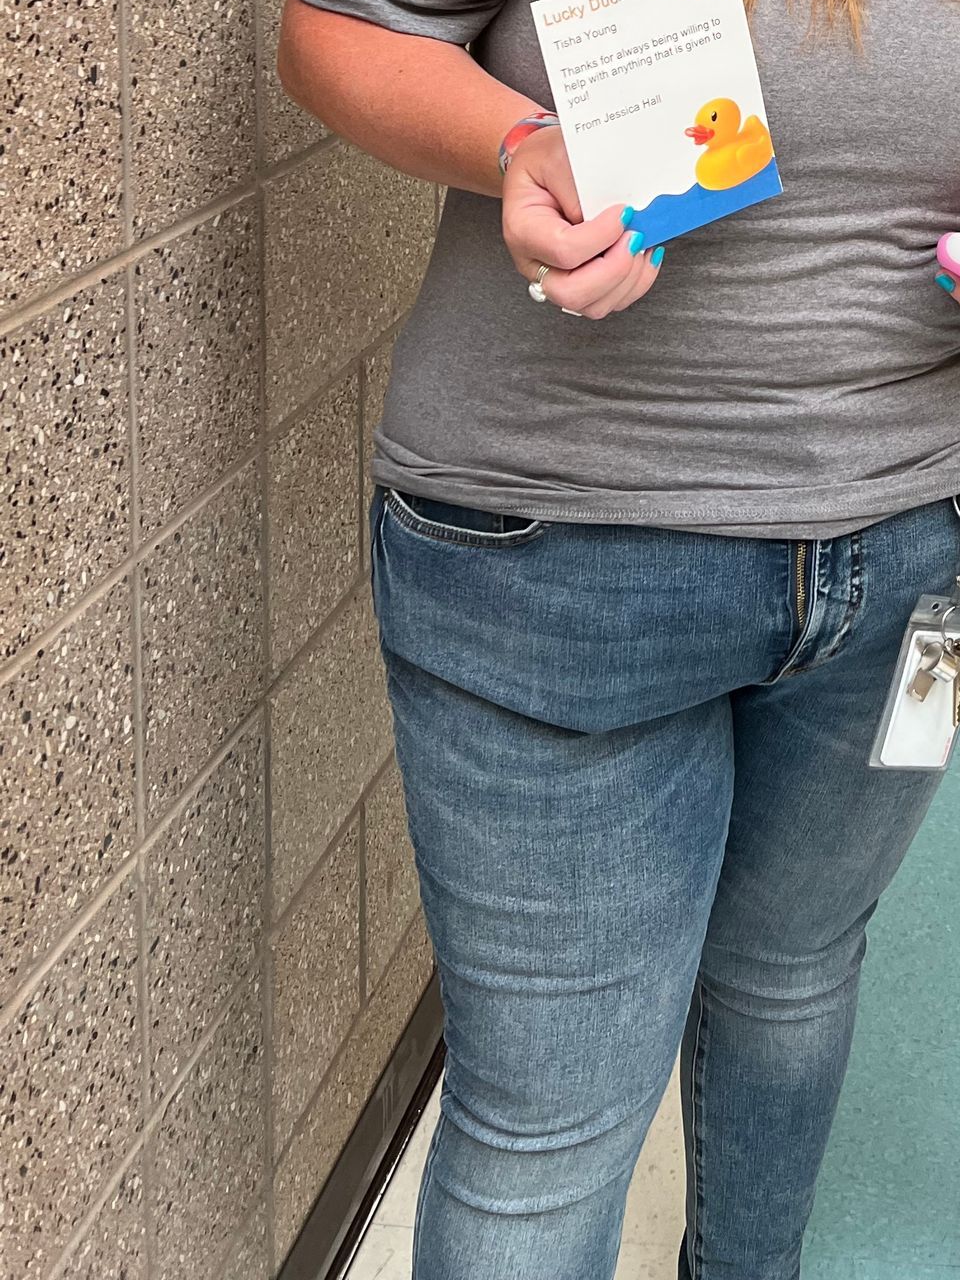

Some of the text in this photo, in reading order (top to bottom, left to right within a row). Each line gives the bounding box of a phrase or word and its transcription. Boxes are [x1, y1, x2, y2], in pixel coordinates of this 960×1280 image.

[543, 4, 585, 26] Lucky
[553, 23, 617, 51] Tisha Young
[560, 17, 721, 78] Thanks for always being willing to
[563, 31, 722, 93] help with anything that is given to
[567, 91, 590, 109] you!
[574, 94, 662, 134] From Jessica Hall
